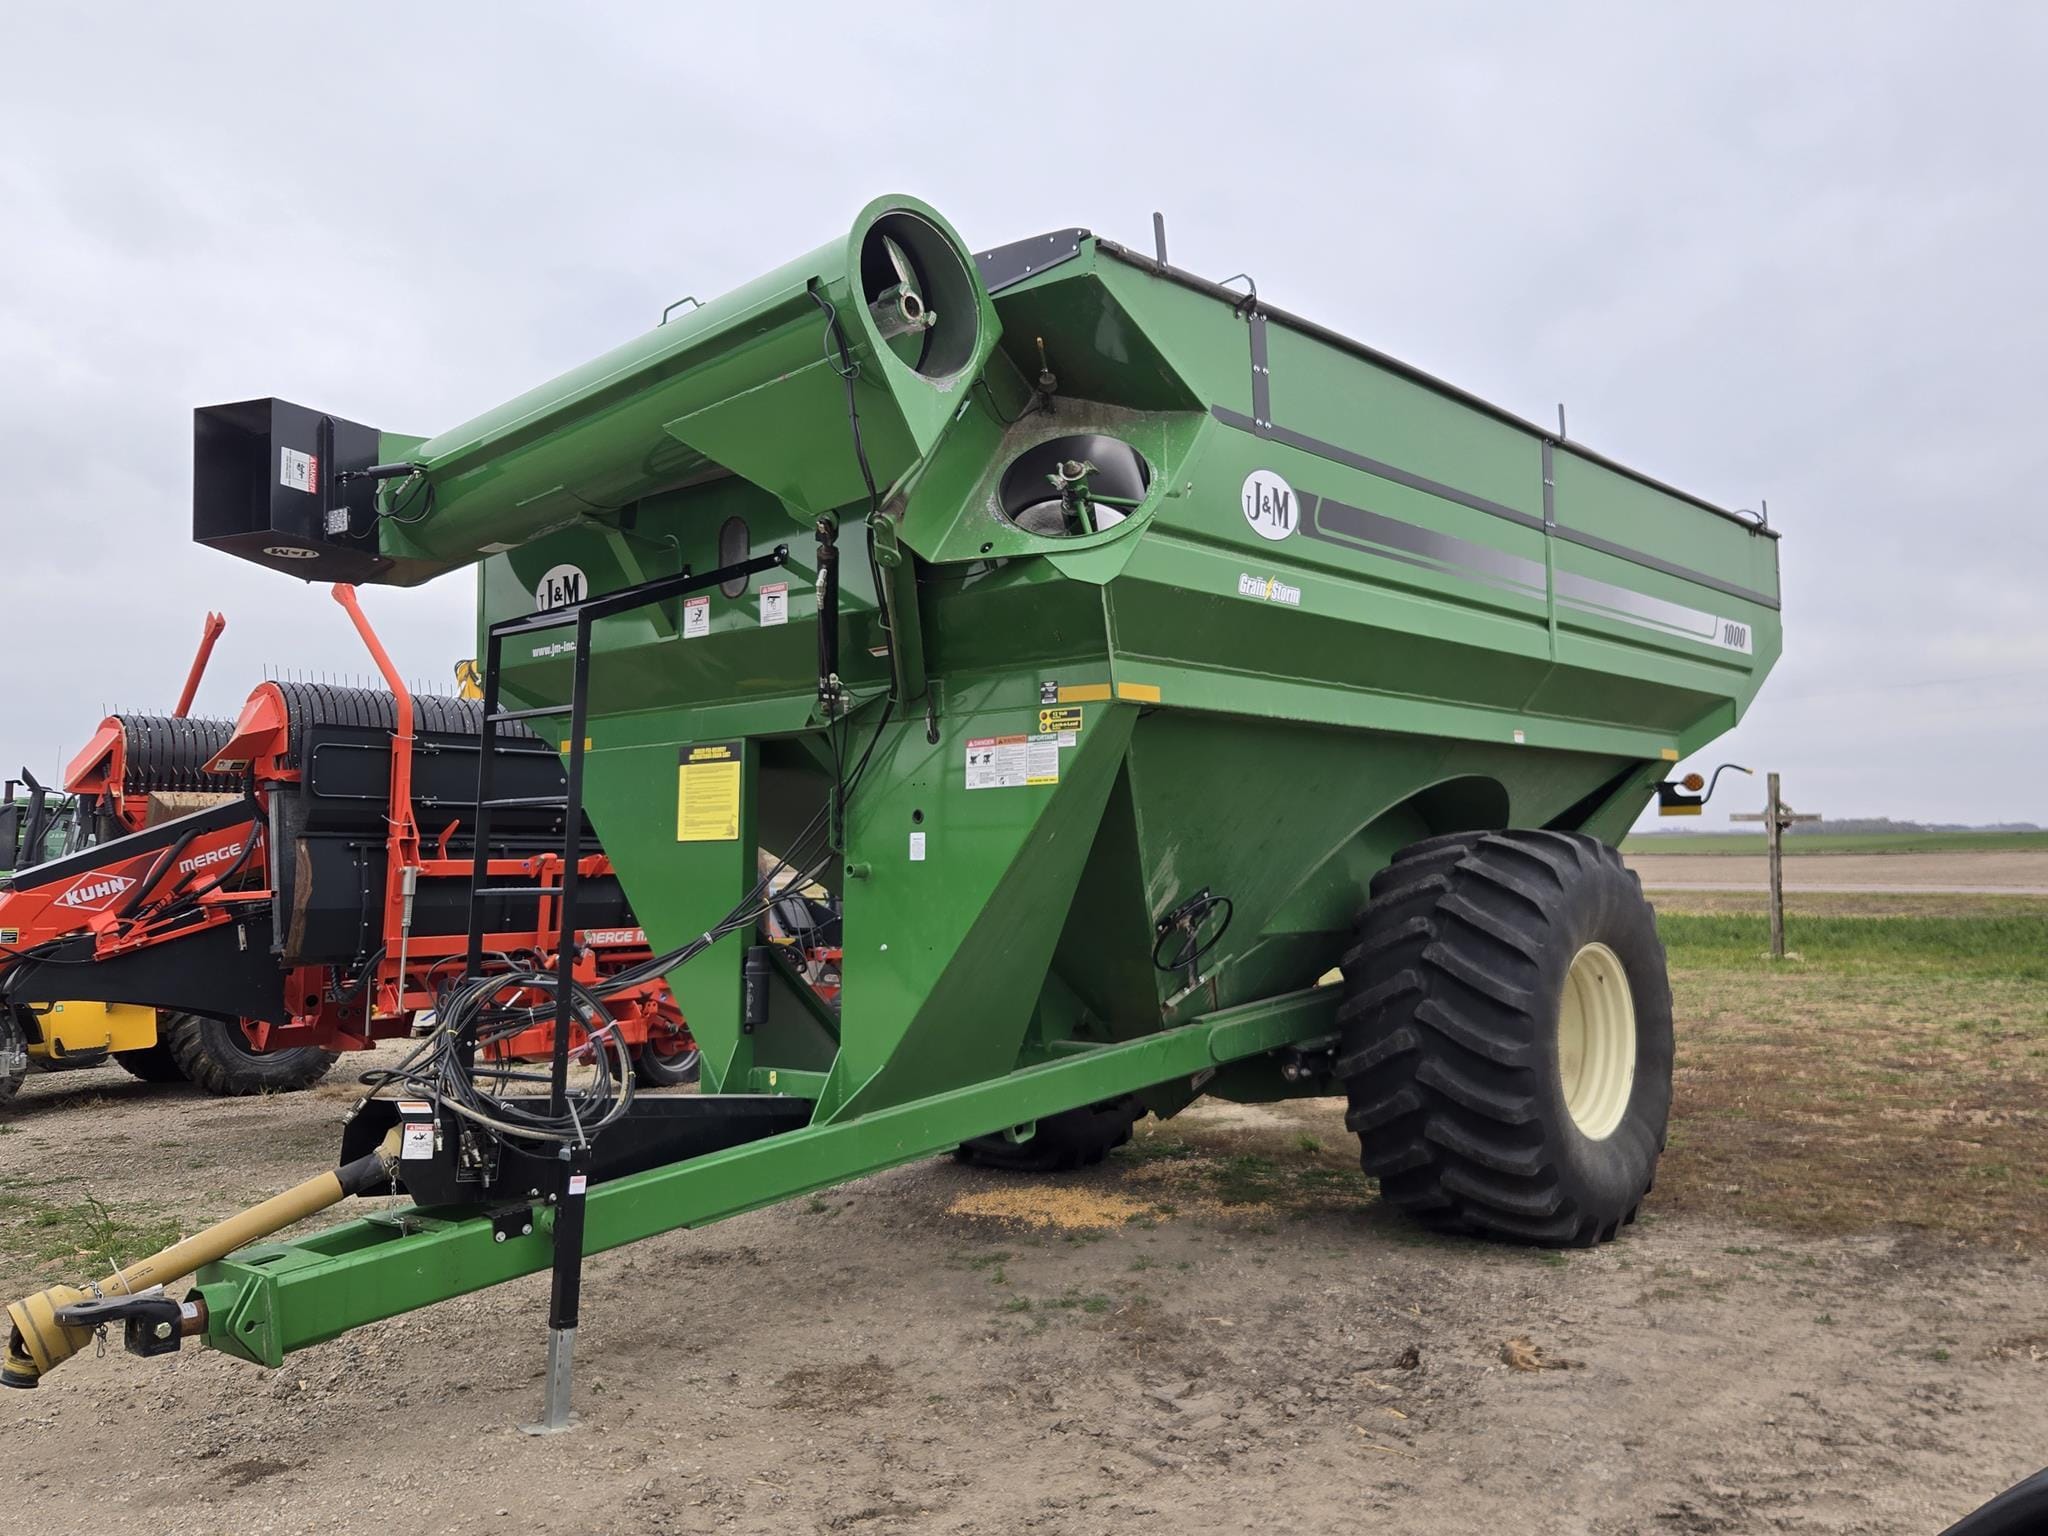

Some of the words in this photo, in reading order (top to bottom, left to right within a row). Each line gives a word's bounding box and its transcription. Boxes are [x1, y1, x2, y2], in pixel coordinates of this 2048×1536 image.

[1246, 481, 1291, 530] J&M
[540, 573, 580, 611] J&M
[1239, 573, 1266, 600] Grain
[1271, 579, 1301, 607] Storm
[1724, 623, 1746, 649] 1000
[179, 843, 242, 873] MERGE
[65, 877, 126, 906] KUHN
